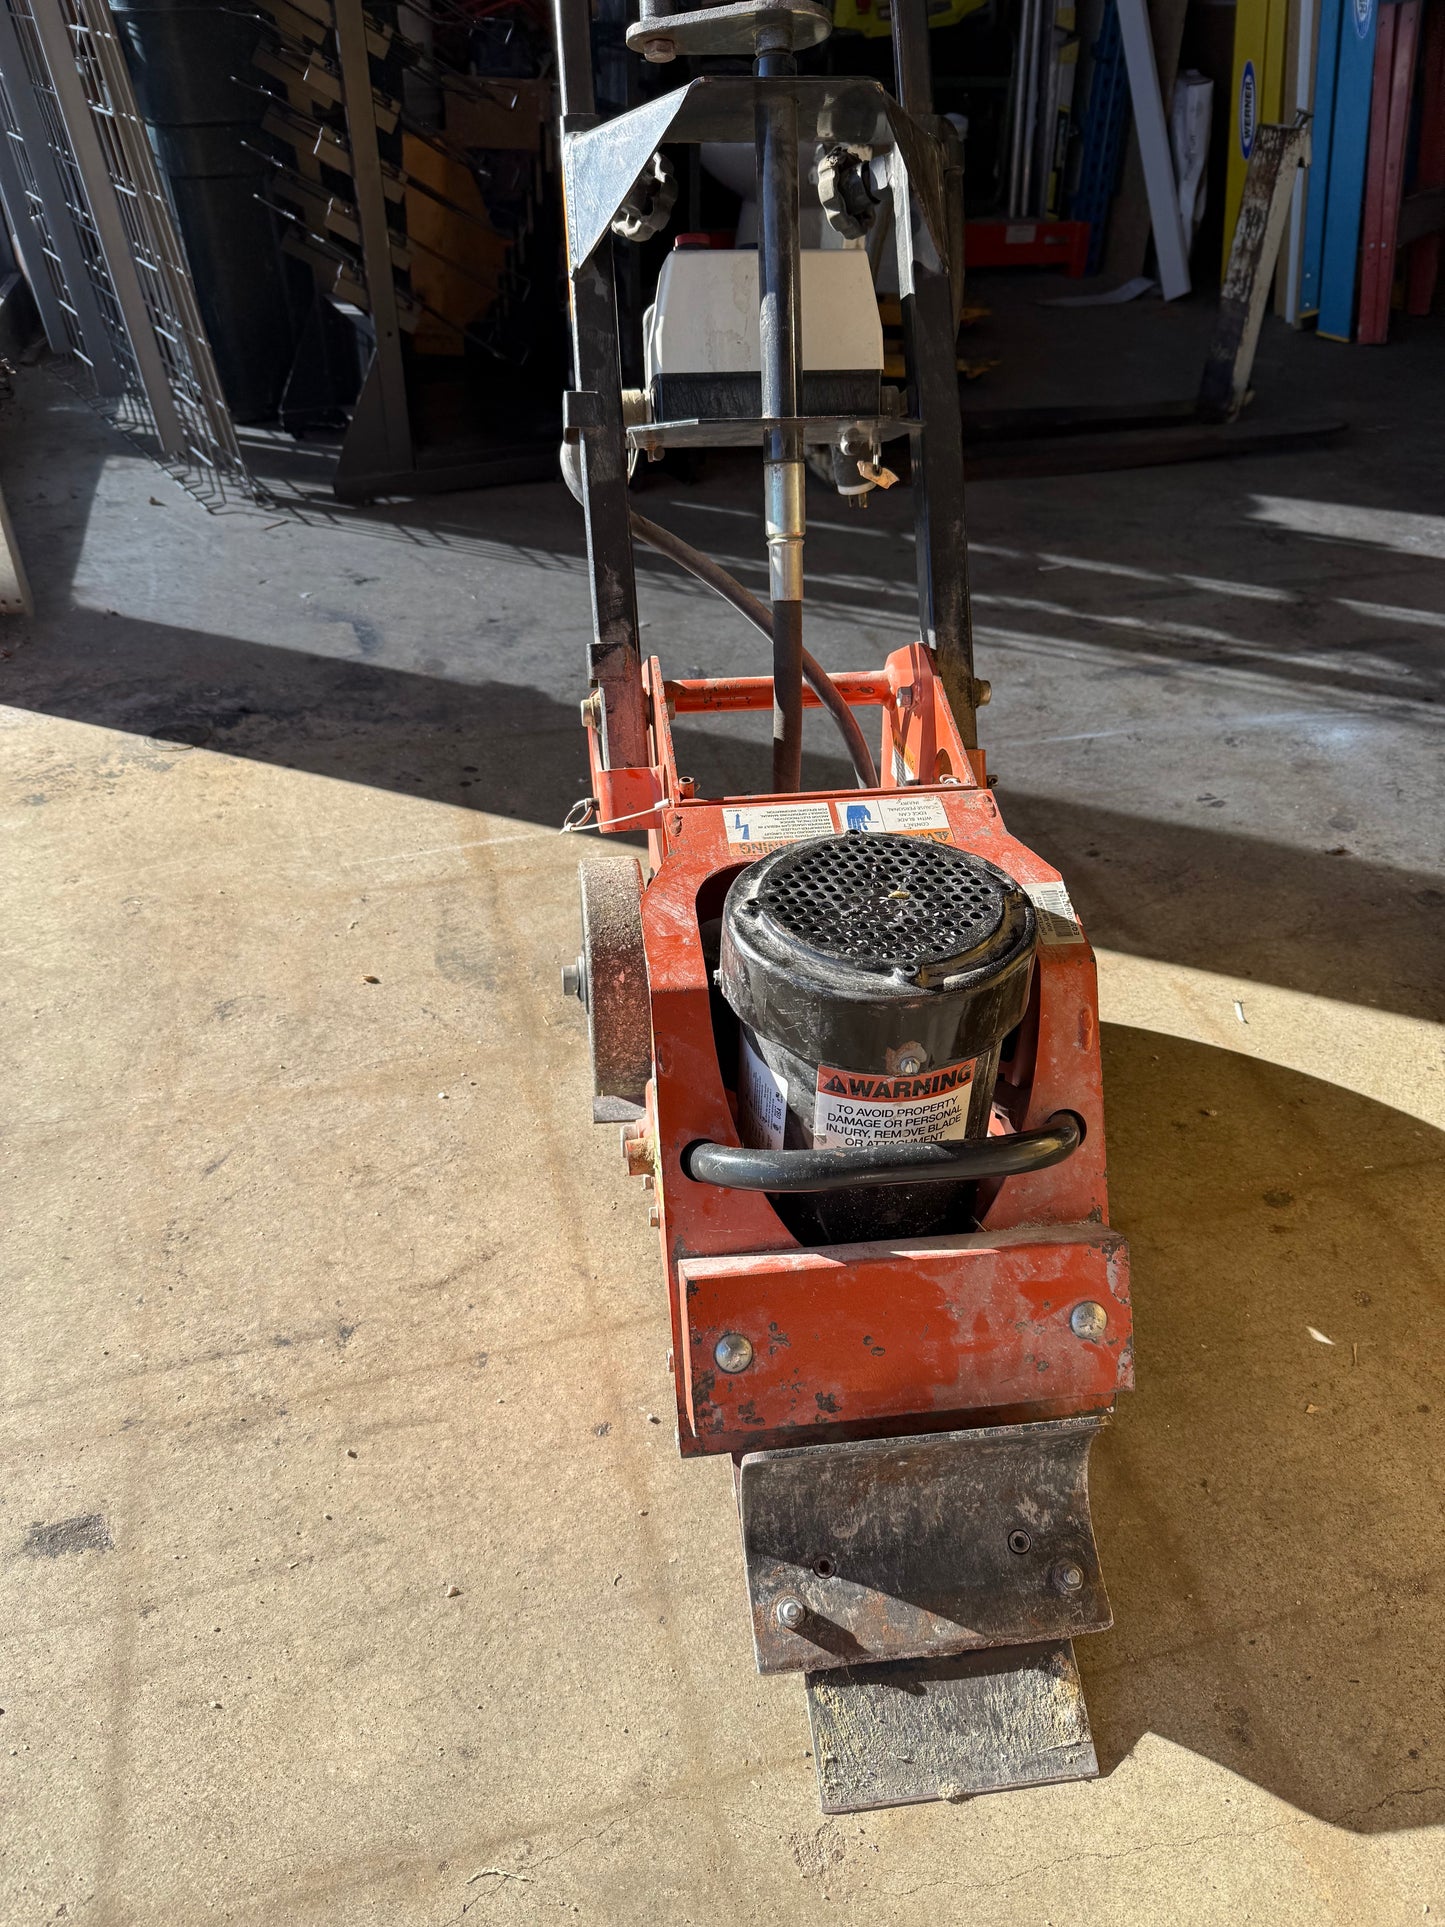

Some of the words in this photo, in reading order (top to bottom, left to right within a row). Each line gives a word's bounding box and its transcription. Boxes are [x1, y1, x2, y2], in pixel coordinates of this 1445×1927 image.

[1243, 81, 1253, 139] WERNER
[848, 1065, 972, 1098] WARNING
[827, 1113, 881, 1128] DAMAGE
[884, 1119, 903, 1128] OR
[905, 1104, 962, 1127] PERSONAL
[836, 1103, 854, 1115] TO
[856, 1107, 894, 1118] AVOID
[897, 1095, 959, 1117] PROPERTY
[826, 1122, 871, 1139] INJURY,
[874, 1126, 926, 1139] REMOVE
[927, 1113, 961, 1133] BLADE
[844, 1137, 864, 1147] OR
